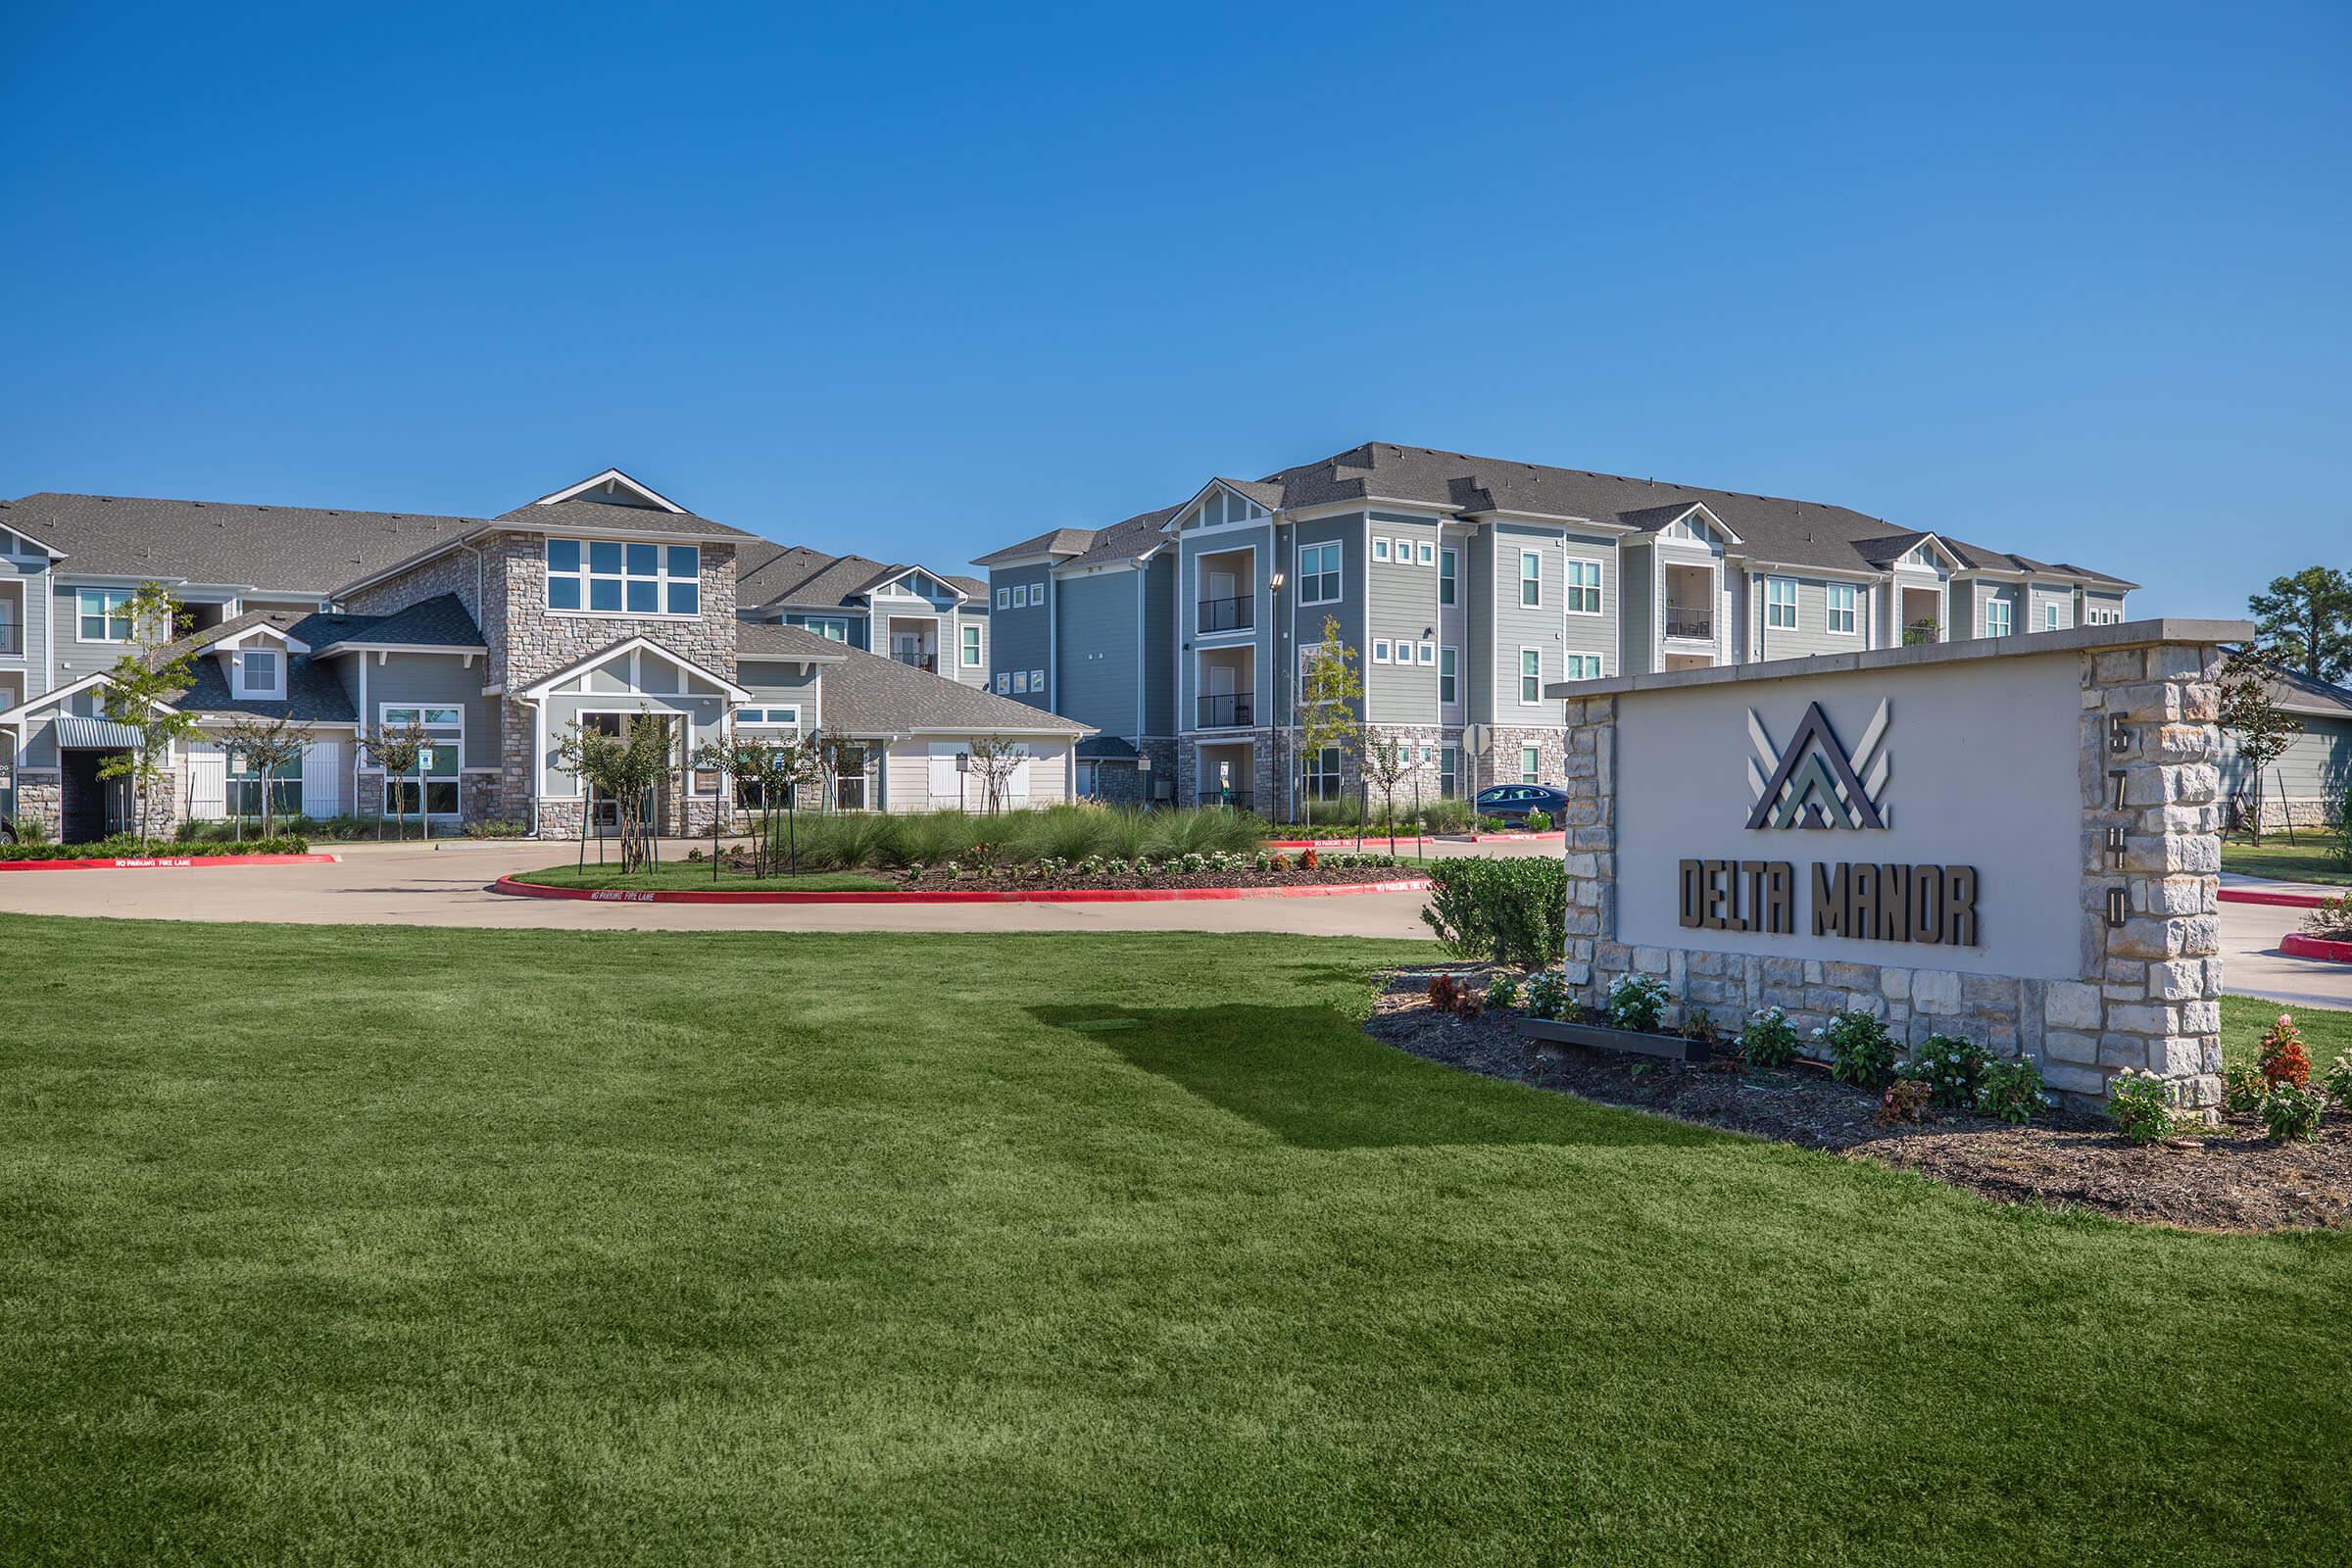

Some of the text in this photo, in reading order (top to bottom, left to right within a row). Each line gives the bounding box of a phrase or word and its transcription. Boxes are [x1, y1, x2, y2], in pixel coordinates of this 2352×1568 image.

[624, 892, 637, 901] FIRE
[1678, 858, 1977, 947] DELTA MANOR
